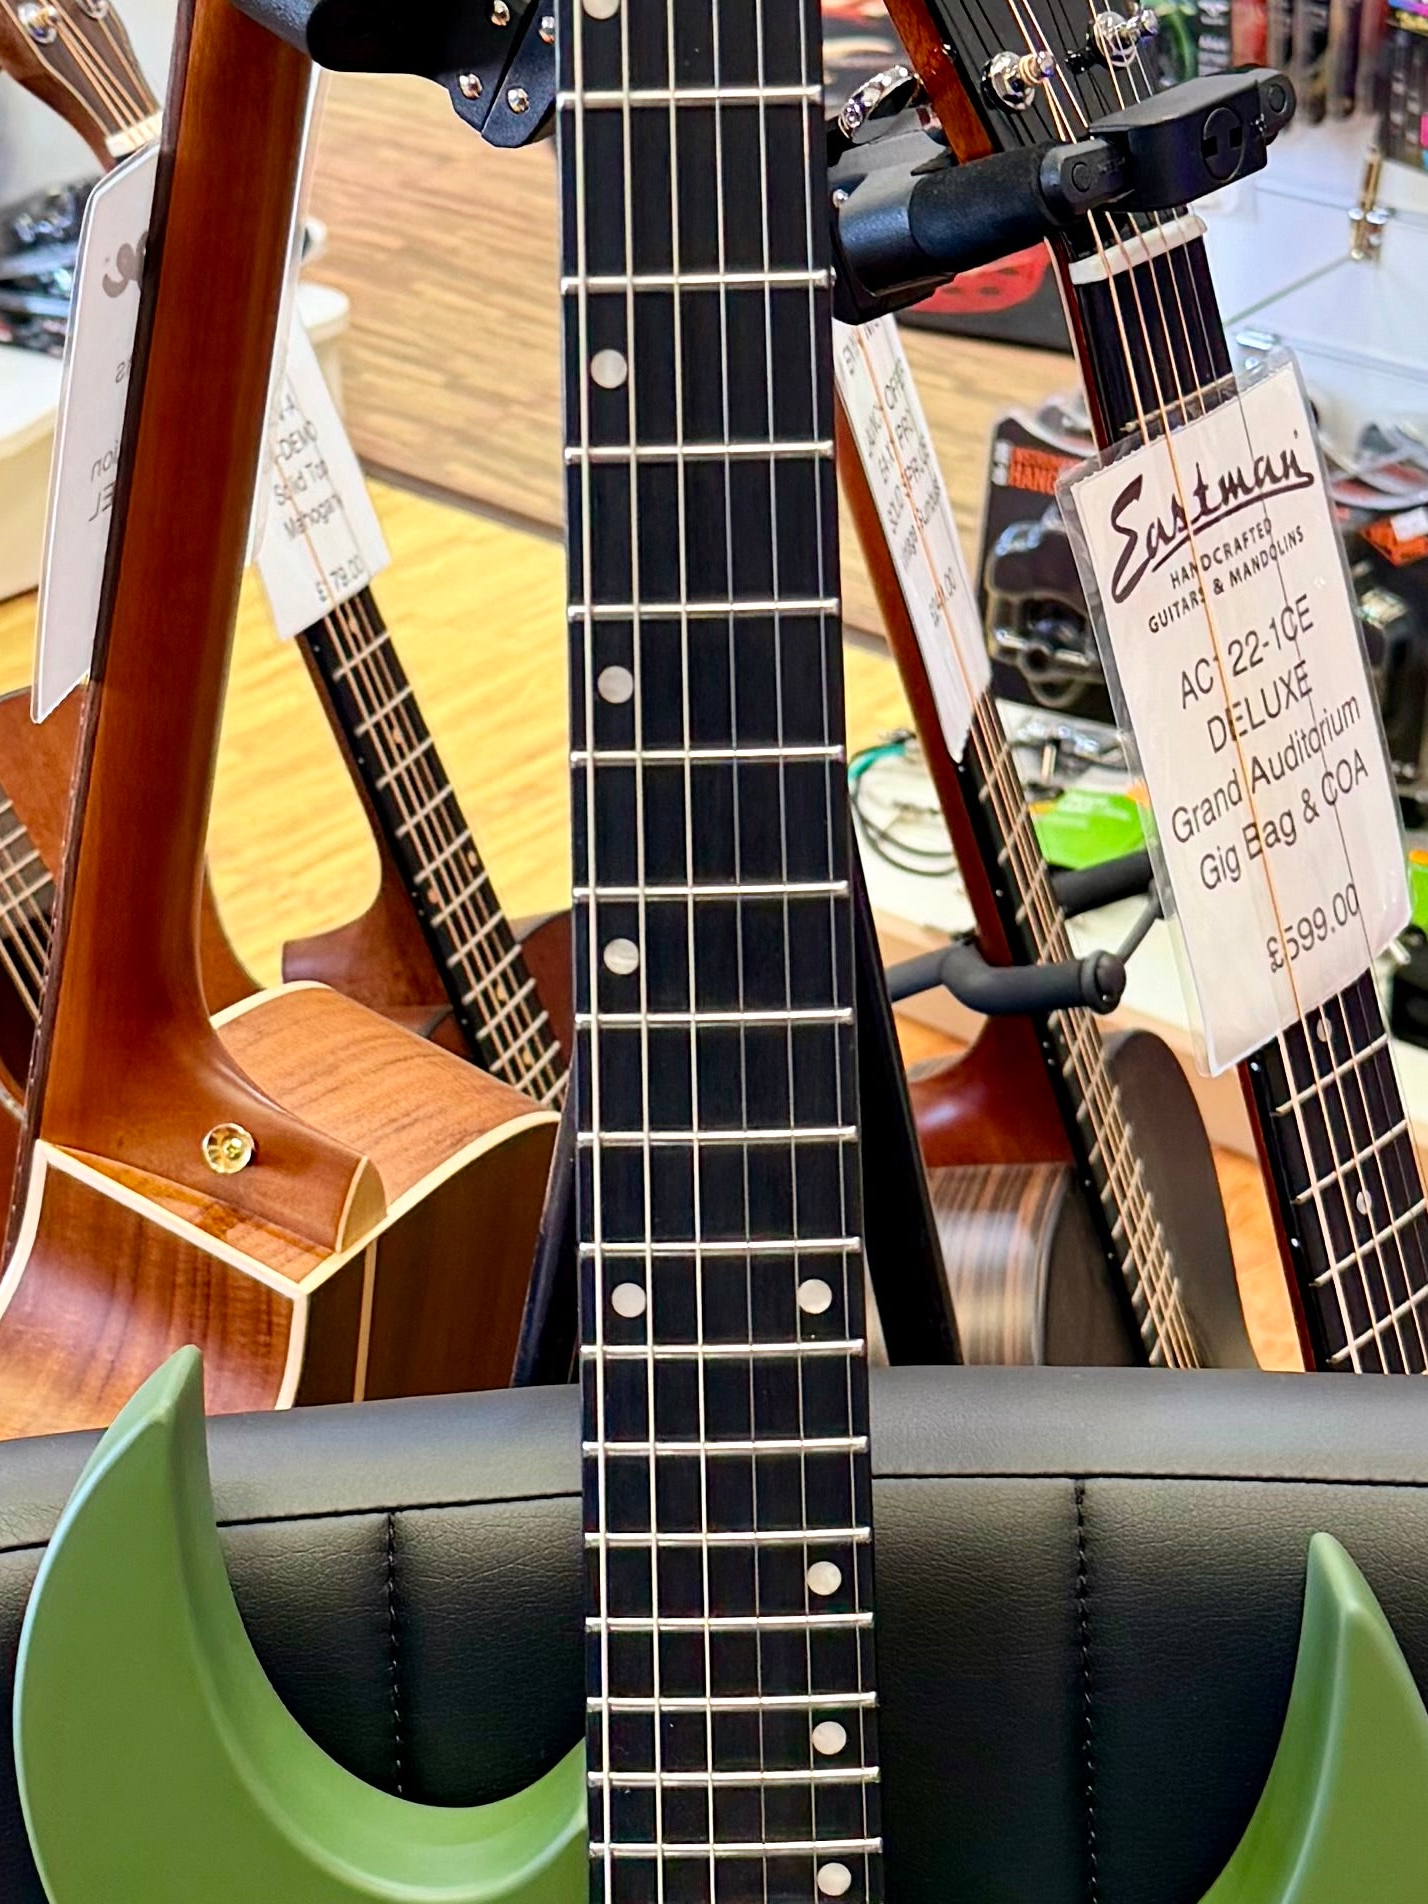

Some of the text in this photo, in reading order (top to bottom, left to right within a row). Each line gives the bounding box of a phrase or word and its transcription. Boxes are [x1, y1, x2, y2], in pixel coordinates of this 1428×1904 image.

[1111, 449, 1315, 604] Eastman
[1169, 517, 1273, 590] HANDCRAFTED
[1213, 577, 1226, 596] &
[1228, 525, 1305, 589] MANDOLINS
[315, 553, 368, 604] £79.00
[1181, 593, 1315, 710] AC22-1CE
[1206, 659, 1314, 755] DELUXE
[1172, 694, 1362, 846] Grand Auditorium
[1200, 757, 1370, 892] Gig Bag & COA
[1266, 882, 1362, 974] £599.00
